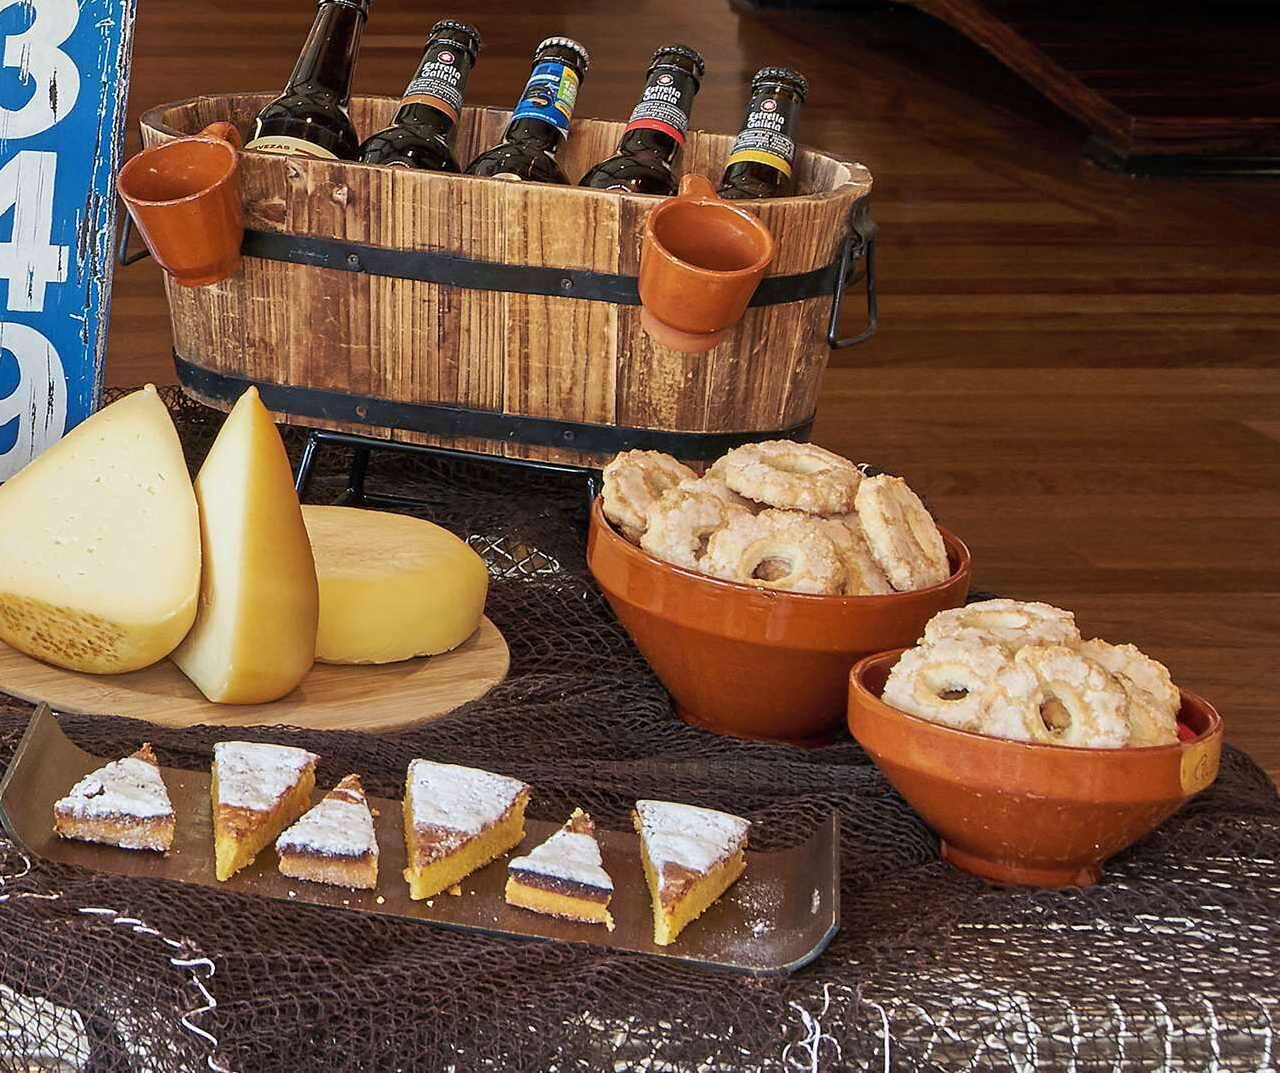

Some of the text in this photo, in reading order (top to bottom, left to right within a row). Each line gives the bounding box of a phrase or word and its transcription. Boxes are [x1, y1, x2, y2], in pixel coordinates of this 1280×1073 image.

[421, 67, 458, 86] Galicia
[422, 61, 461, 80] Estrella
[642, 91, 678, 105] Galicia
[644, 85, 681, 99] Estrella
[747, 111, 785, 124] Estrella
[747, 118, 782, 131] Galicia
